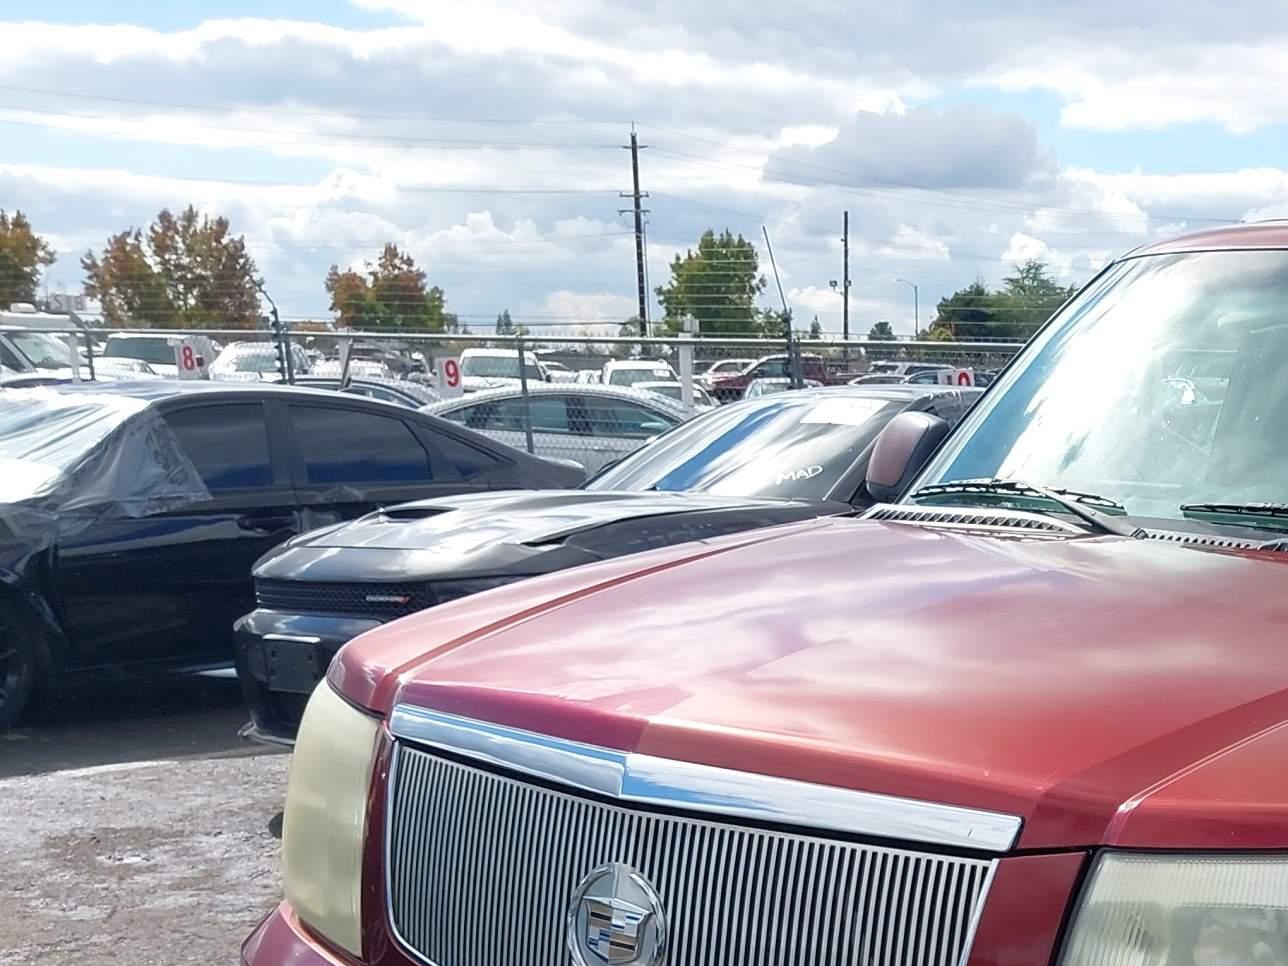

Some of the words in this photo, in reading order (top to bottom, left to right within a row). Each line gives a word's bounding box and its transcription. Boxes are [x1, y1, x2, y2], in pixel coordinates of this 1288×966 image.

[183, 346, 195, 370] 8
[445, 360, 459, 387] 9
[776, 465, 823, 486] MAD
